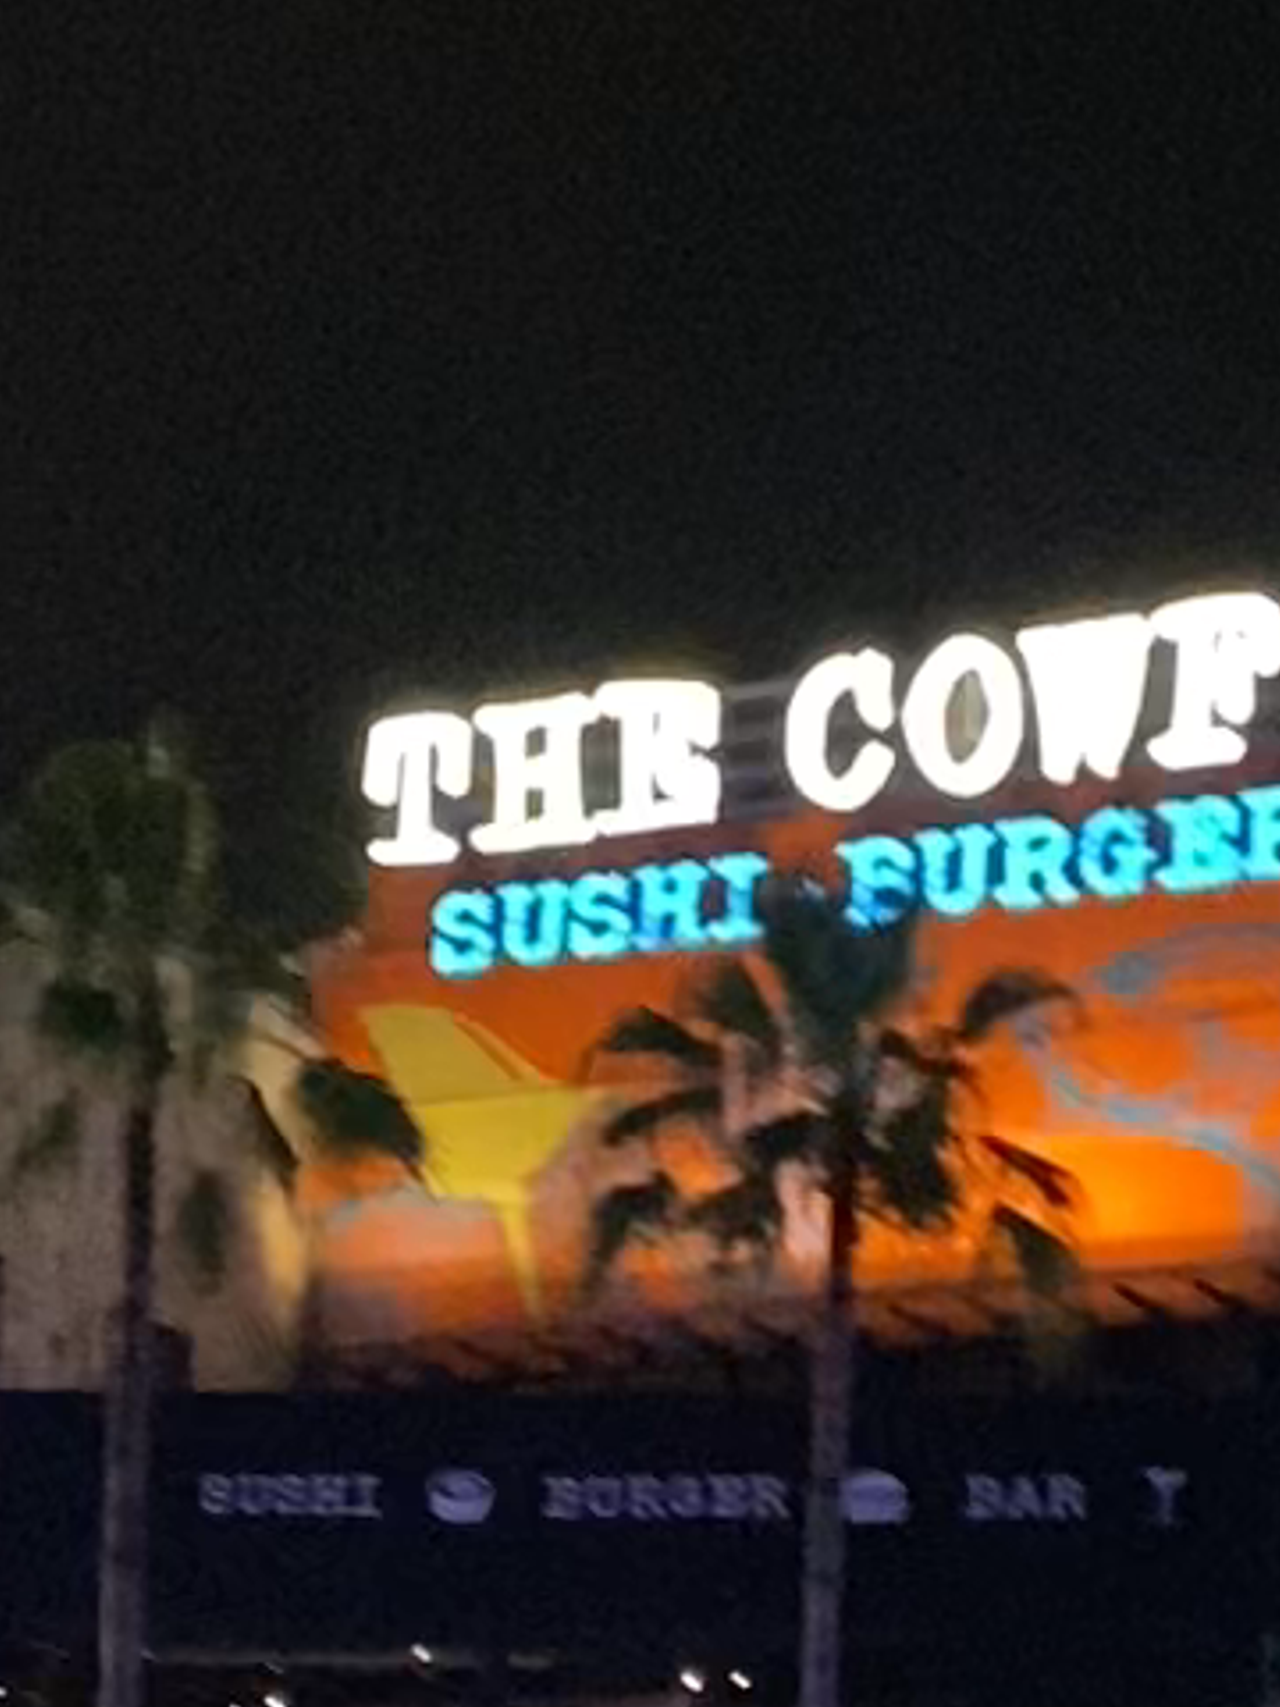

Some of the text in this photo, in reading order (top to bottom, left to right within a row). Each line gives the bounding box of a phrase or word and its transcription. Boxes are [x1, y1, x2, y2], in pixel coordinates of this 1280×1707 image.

[362, 679, 722, 867] THE
[429, 851, 770, 978] SUSHI
[199, 1473, 1088, 1519] SUSHI BURGER BAR
